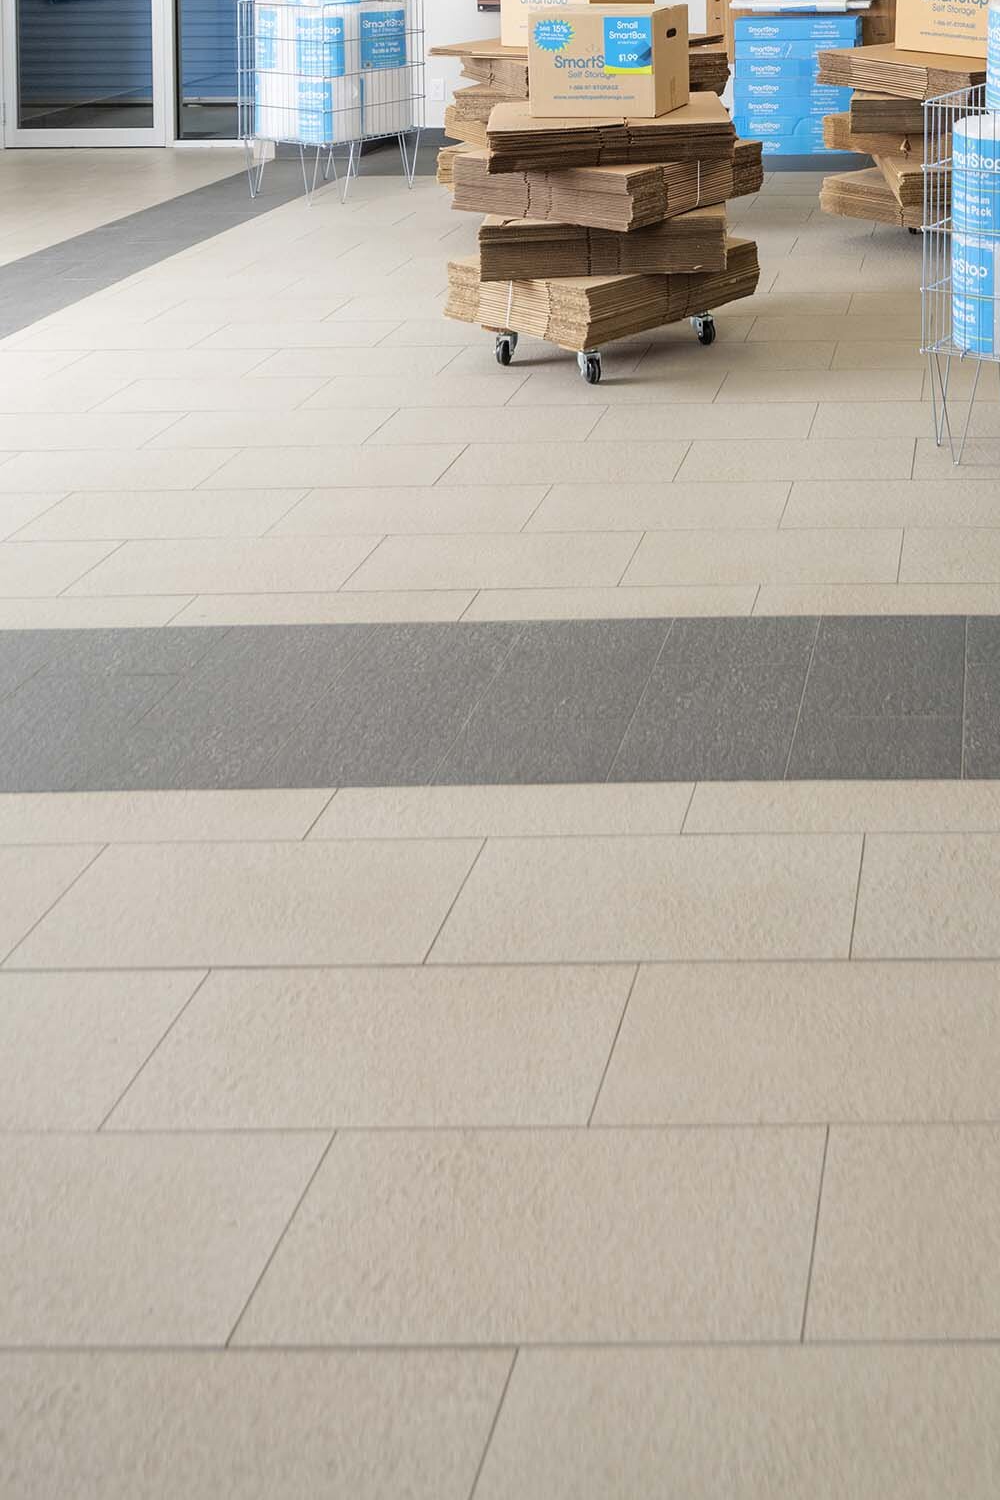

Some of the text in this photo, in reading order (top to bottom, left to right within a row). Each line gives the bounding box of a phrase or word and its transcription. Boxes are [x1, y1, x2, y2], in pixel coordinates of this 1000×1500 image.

[932, 3, 977, 17] Self Storage
[617, 20, 639, 30] Small
[608, 30, 647, 40] SmartBox
[554, 54, 605, 69] SmartS
[618, 53, 639, 63] $1.99
[568, 70, 583, 79] Self
